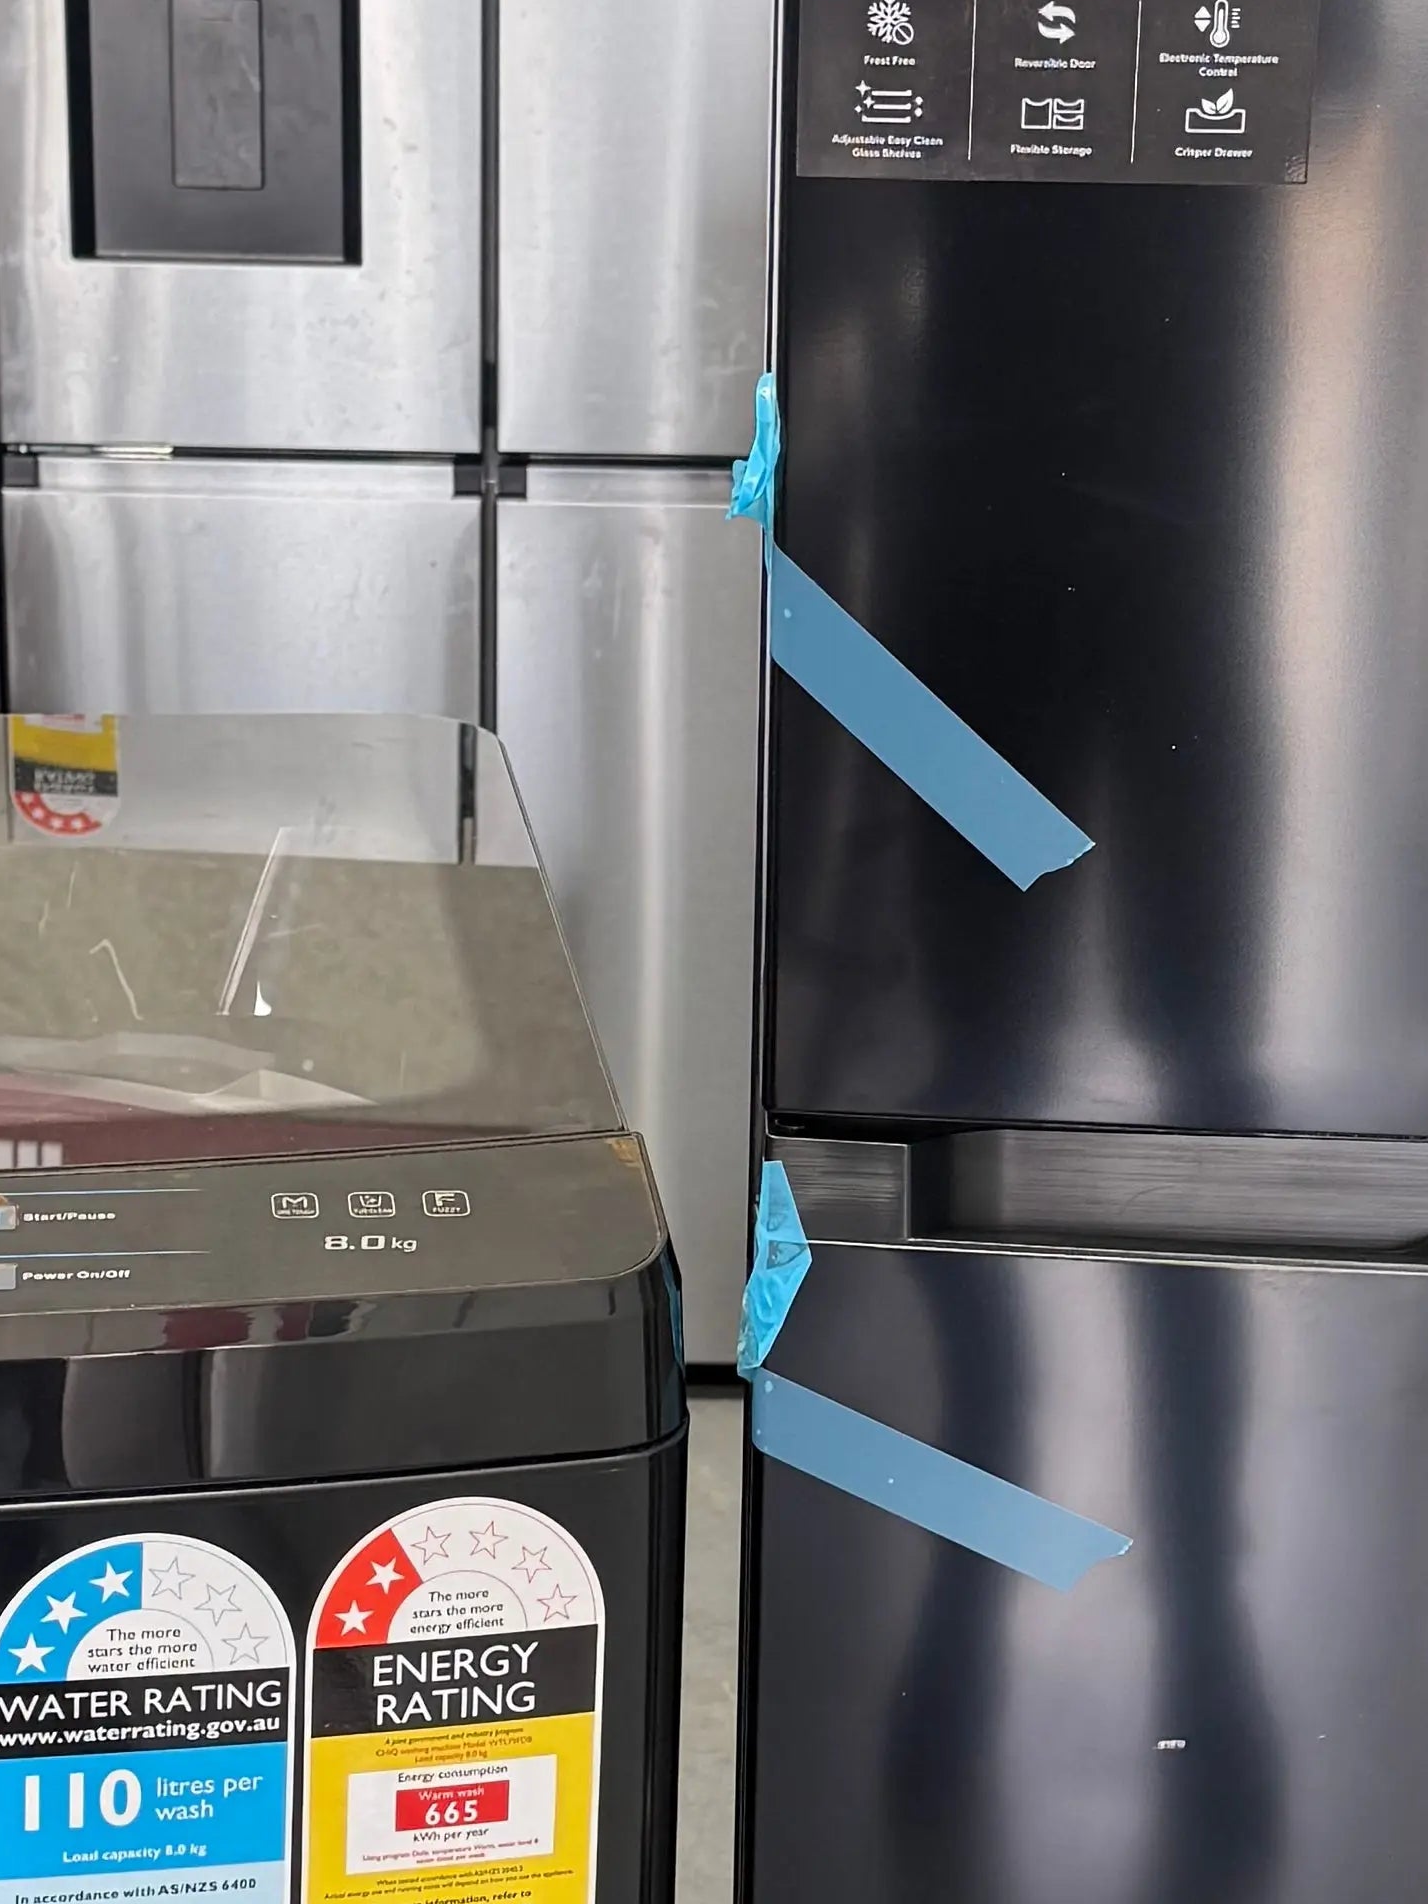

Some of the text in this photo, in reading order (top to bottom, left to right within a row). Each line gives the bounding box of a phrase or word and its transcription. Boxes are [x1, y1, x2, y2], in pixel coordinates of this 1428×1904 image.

[863, 55, 916, 67] Frost Free
[1070, 58, 1096, 69] Door
[1158, 52, 1279, 65] Electronic Temperature
[1198, 66, 1238, 77] Control
[888, 136, 912, 147] Easy
[913, 136, 944, 146] Clean
[1052, 144, 1093, 157] Storage
[1174, 146, 1254, 159] Crisper Drawer
[22, 1211, 116, 1222] Start/Pause
[324, 1235, 417, 1253] 8.0 kg
[22, 1269, 132, 1281] Power On/Off
[428, 1589, 489, 1602] The more
[411, 1603, 504, 1620] stars the more
[106, 1627, 181, 1642] The more
[409, 1617, 504, 1636] energy efficient
[87, 1642, 198, 1658] stars the more
[88, 1657, 196, 1674] water efficient
[373, 1641, 540, 1688] ENERGY
[143, 1680, 281, 1715] RATING
[376, 1681, 536, 1726] RATING
[398, 1765, 508, 1784] Energy consumption
[23, 1769, 263, 1832] 110 litres per
[418, 1786, 485, 1801] Warm wash
[155, 1800, 214, 1822] wash
[425, 1800, 478, 1826] 665
[413, 1827, 490, 1843] kWh per year
[62, 1843, 208, 1863] Load capacity kg
[33, 1889, 119, 1904] accordance
[123, 1885, 155, 1898] with
[157, 1880, 219, 1897] AS/NZS
[492, 1891, 518, 1902] refer
[520, 1889, 532, 1899] to
